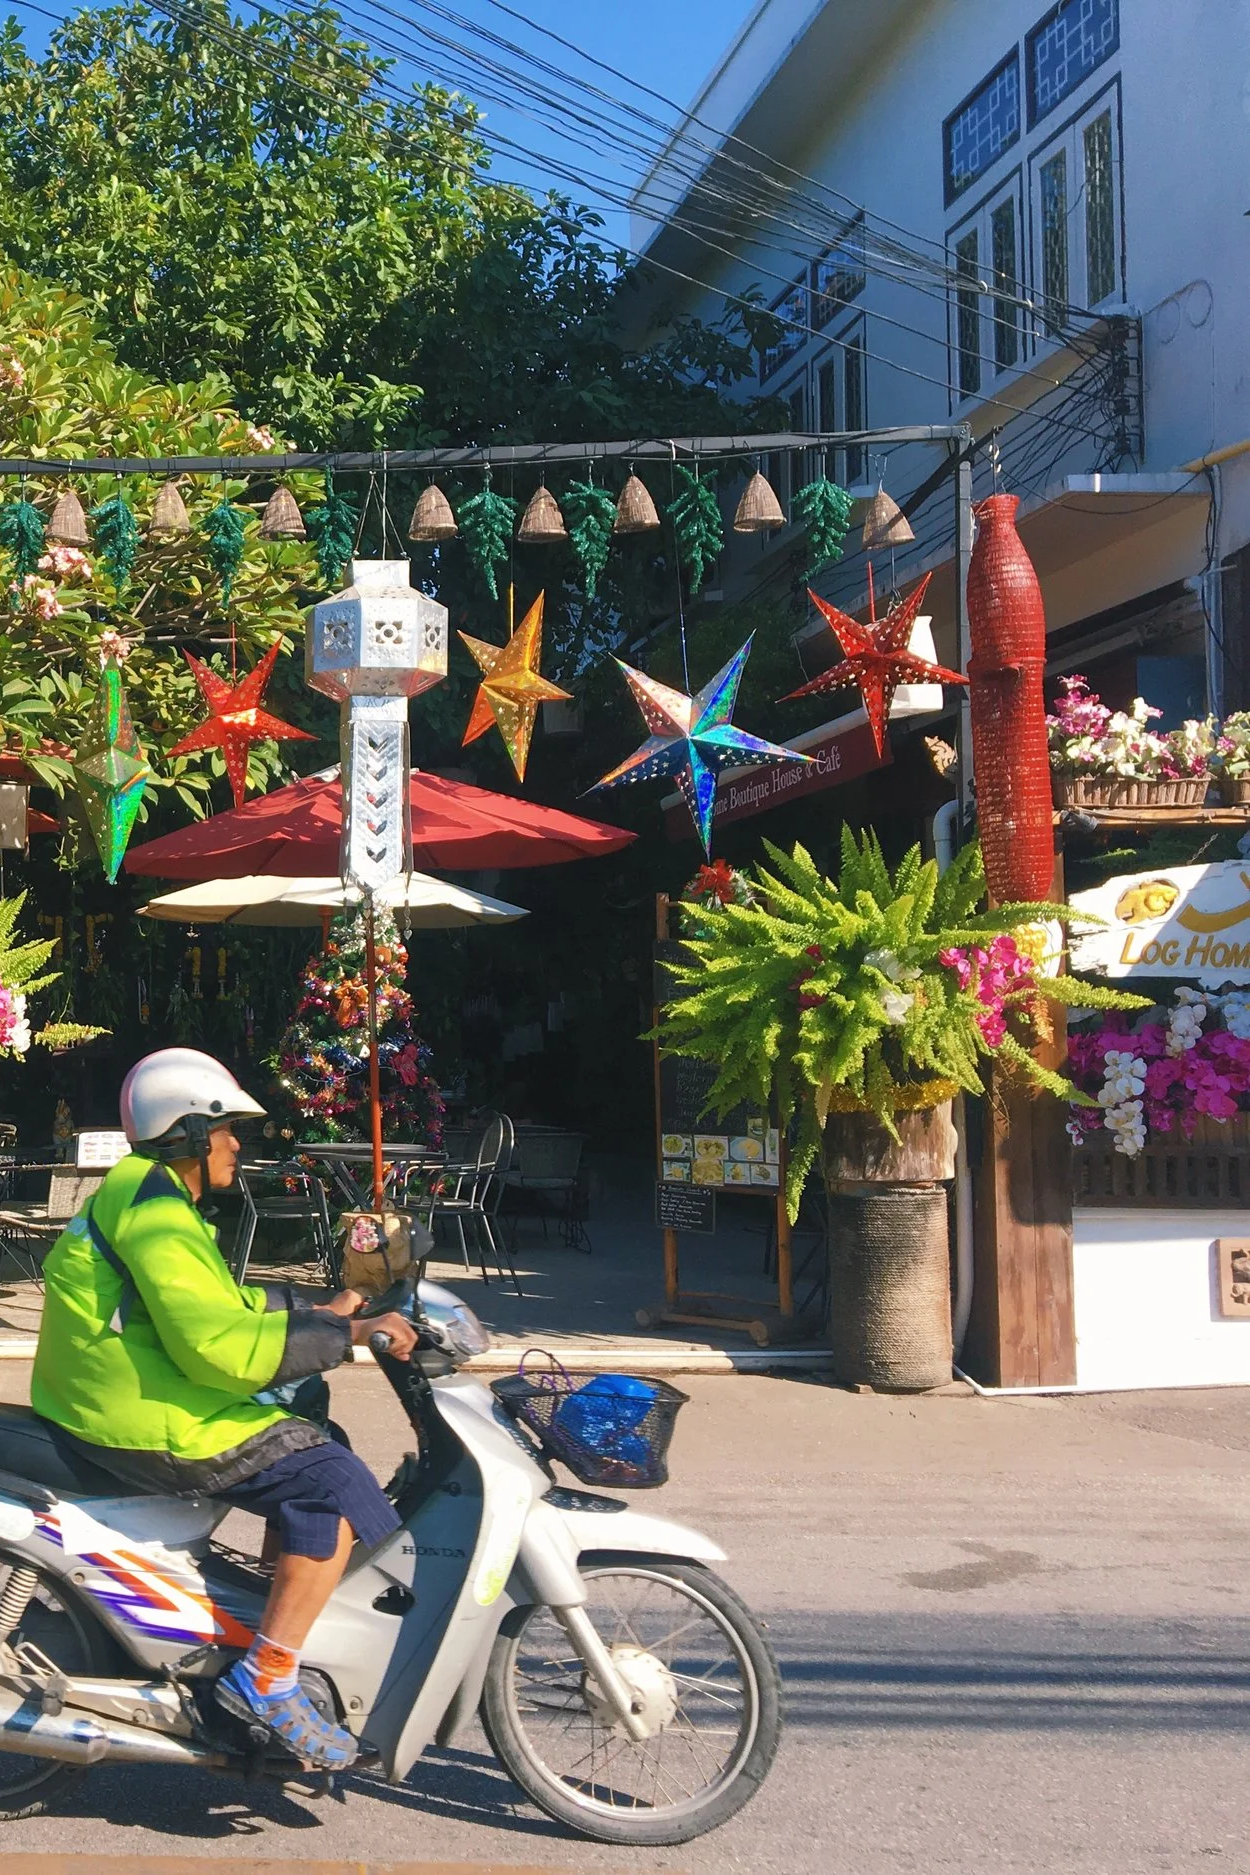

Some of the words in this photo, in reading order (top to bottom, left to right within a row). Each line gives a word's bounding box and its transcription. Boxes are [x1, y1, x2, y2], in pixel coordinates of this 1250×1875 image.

[730, 781, 769, 809] Boutique
[772, 766, 802, 793] House
[816, 745, 841, 774] Café
[402, 1545, 466, 1558] HONDA
